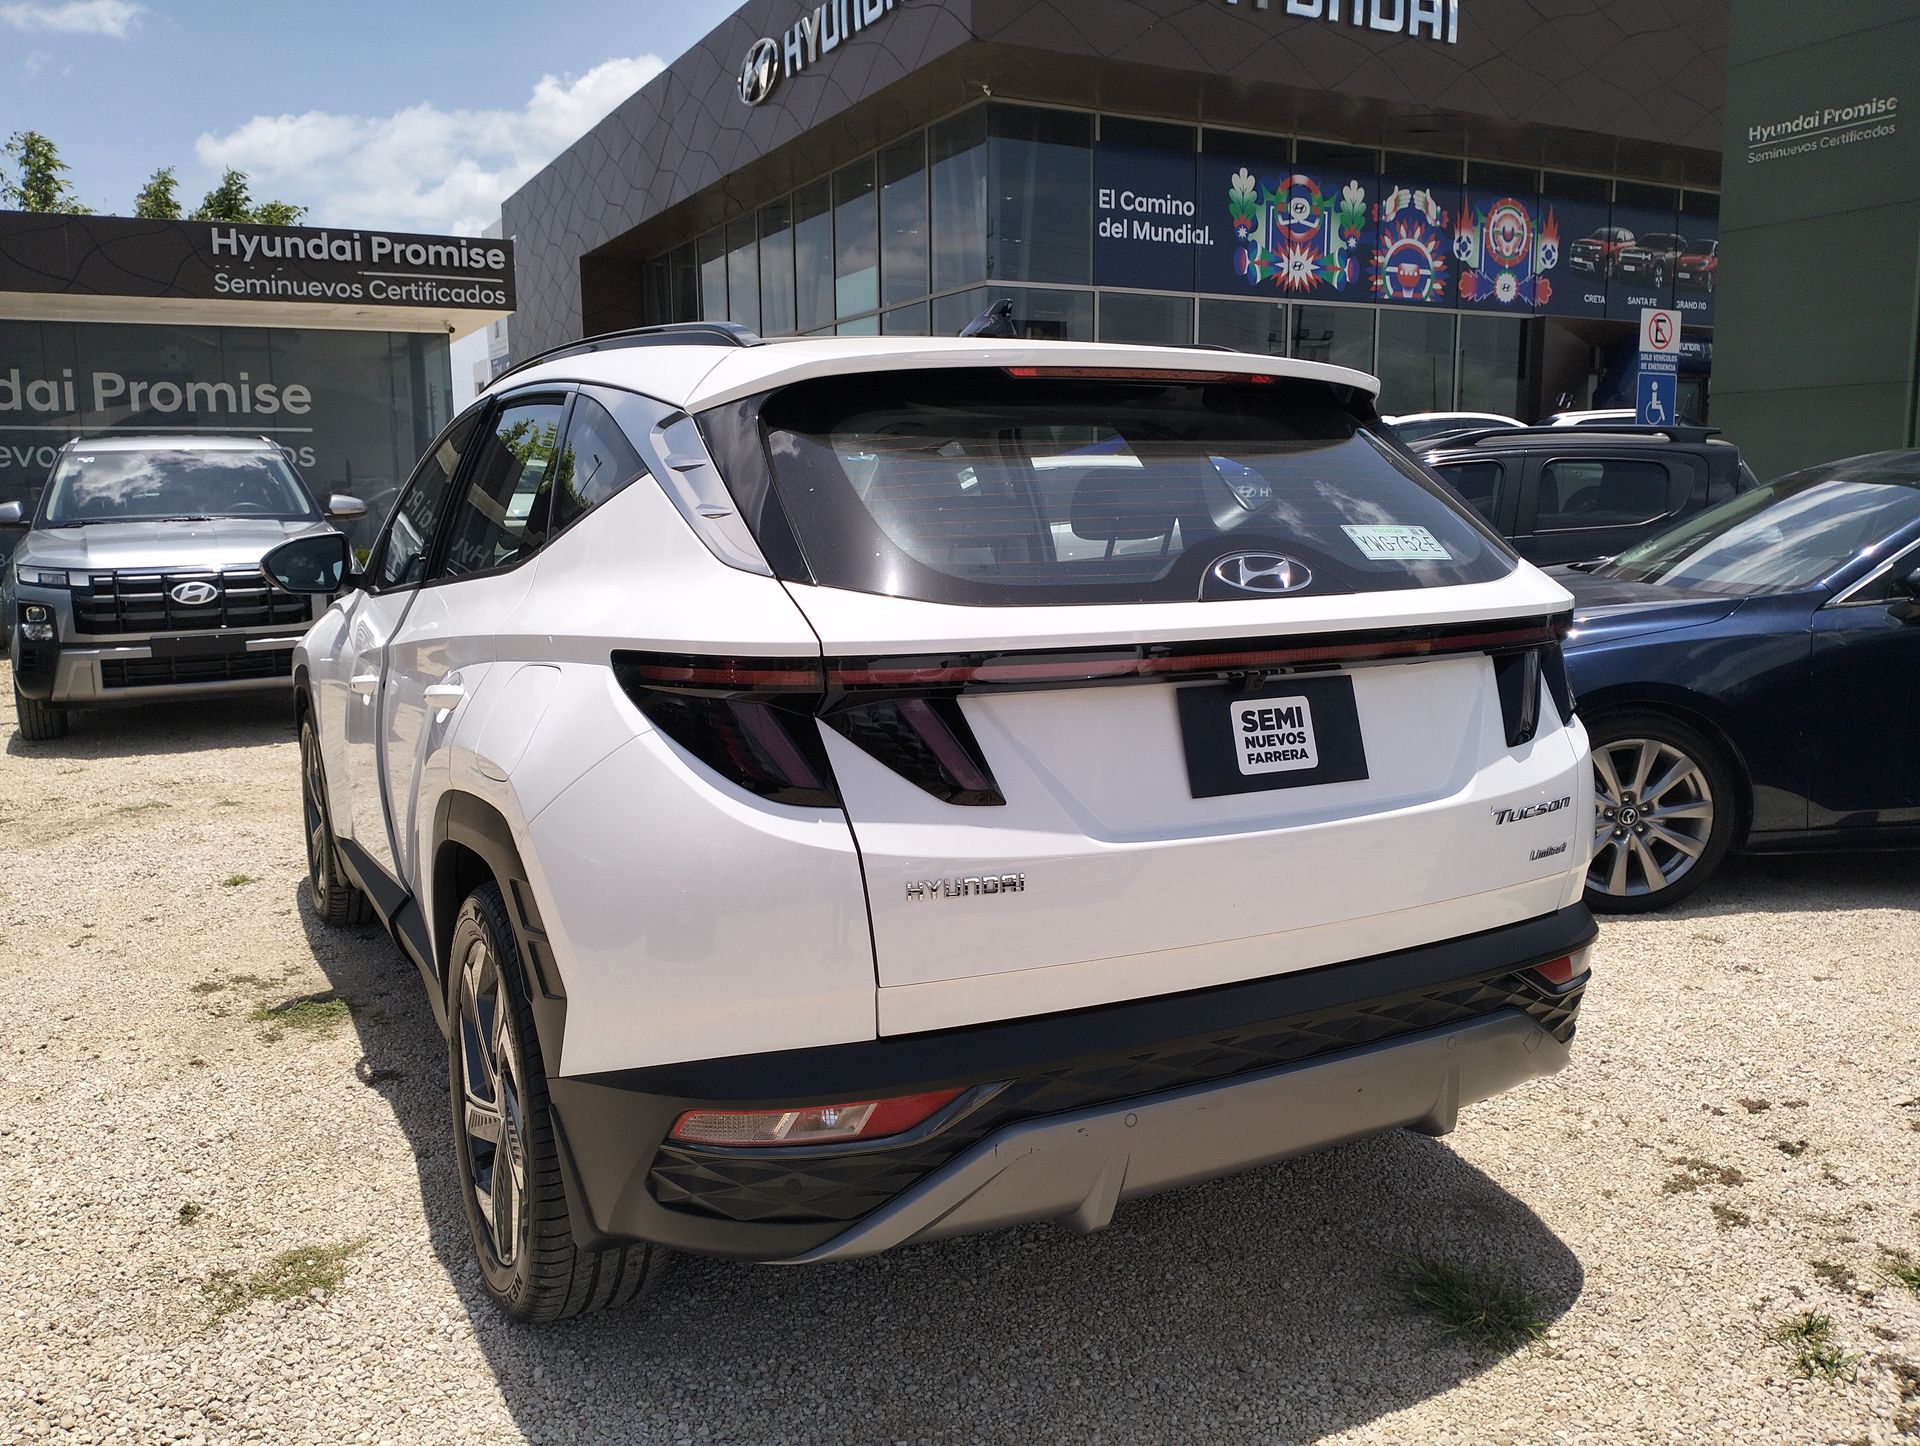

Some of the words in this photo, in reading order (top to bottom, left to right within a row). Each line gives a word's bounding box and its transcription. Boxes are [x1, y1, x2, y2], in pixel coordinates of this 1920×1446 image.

[1748, 110, 1821, 142] Hyundai
[1823, 97, 1898, 125] Promise
[1747, 141, 1818, 164] Seminuevos
[1820, 124, 1897, 149] Certificados
[1099, 188, 1116, 210] El
[1120, 191, 1195, 216] Camino
[1098, 217, 1128, 239] del
[1133, 220, 1214, 246] Mundial.
[210, 227, 362, 263] Hyundai
[371, 235, 506, 270] Promise
[214, 272, 364, 299] Seminuevos
[368, 279, 506, 305] Certificados
[1584, 293, 1605, 304] CRETA
[1627, 296, 1647, 306] SANTA
[1649, 298, 1657, 307] FE
[1641, 353, 1653, 361] SOLO
[1641, 362, 1647, 370] DE
[92, 371, 312, 415] Promise
[1357, 535, 1441, 552] YWG-752-E
[1241, 706, 1304, 733] SEMI
[1244, 732, 1306, 749] NUEVOS
[1247, 748, 1309, 765] FARRERA
[1529, 841, 1567, 861] Limited
[905, 872, 1025, 902] HYUNDAI
